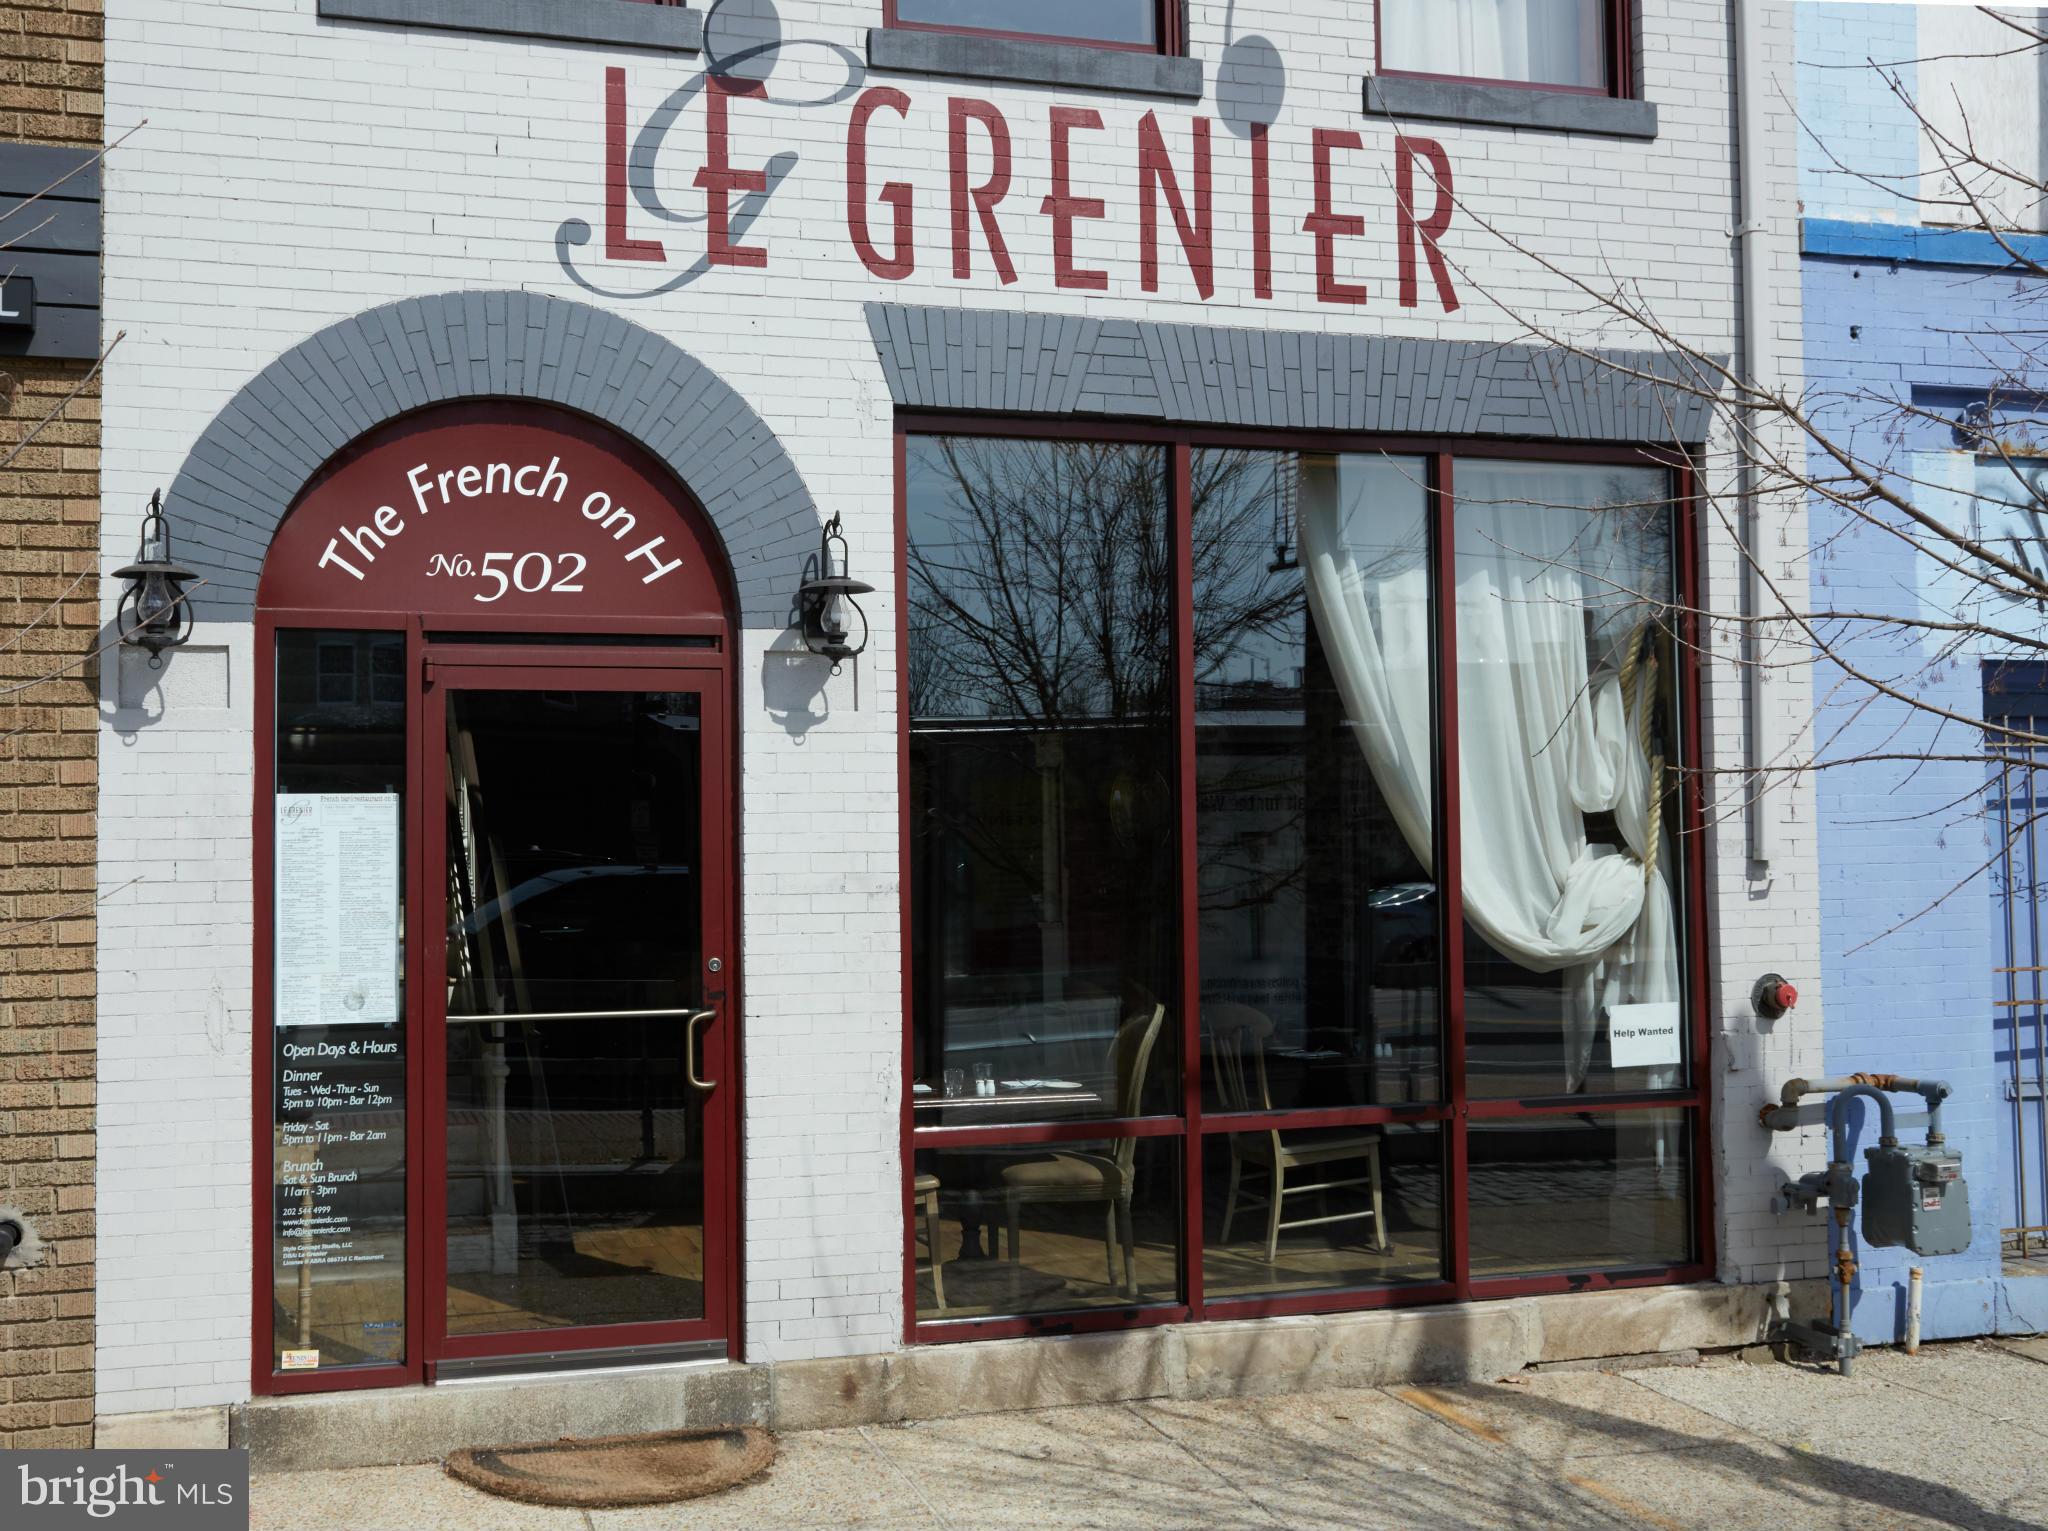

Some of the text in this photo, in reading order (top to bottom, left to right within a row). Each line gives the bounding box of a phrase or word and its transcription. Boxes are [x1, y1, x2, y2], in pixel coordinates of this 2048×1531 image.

[605, 66, 1461, 315] LE GRENIER
[318, 456, 684, 584] The French on H
[1613, 1026, 1674, 1039] Help Wanted
[282, 1040, 398, 1061] Open Days & Hours
[282, 1069, 323, 1082] Dinner
[282, 1086, 303, 1097] Tues
[310, 1084, 331, 1096] Wed
[363, 1082, 380, 1093] Sun
[282, 1098, 304, 1111] 5pm
[305, 1098, 314, 1108] to
[317, 1096, 343, 1109] 10pm
[349, 1095, 365, 1106] Bar
[367, 1094, 393, 1107] 12pm
[282, 1122, 308, 1133] Friday
[315, 1120, 330, 1131] Sat
[282, 1134, 304, 1147] 5pm
[305, 1134, 314, 1144] to
[317, 1132, 343, 1145] 11pm
[349, 1130, 365, 1141] Bar
[367, 1130, 387, 1141] 2am
[283, 1158, 324, 1173] Brunch
[283, 1171, 358, 1186] Sat & Sun Brunch
[284, 1186, 309, 1198] 11am
[316, 1185, 337, 1198] 3pm
[282, 1205, 331, 1216] 202 544 4999
